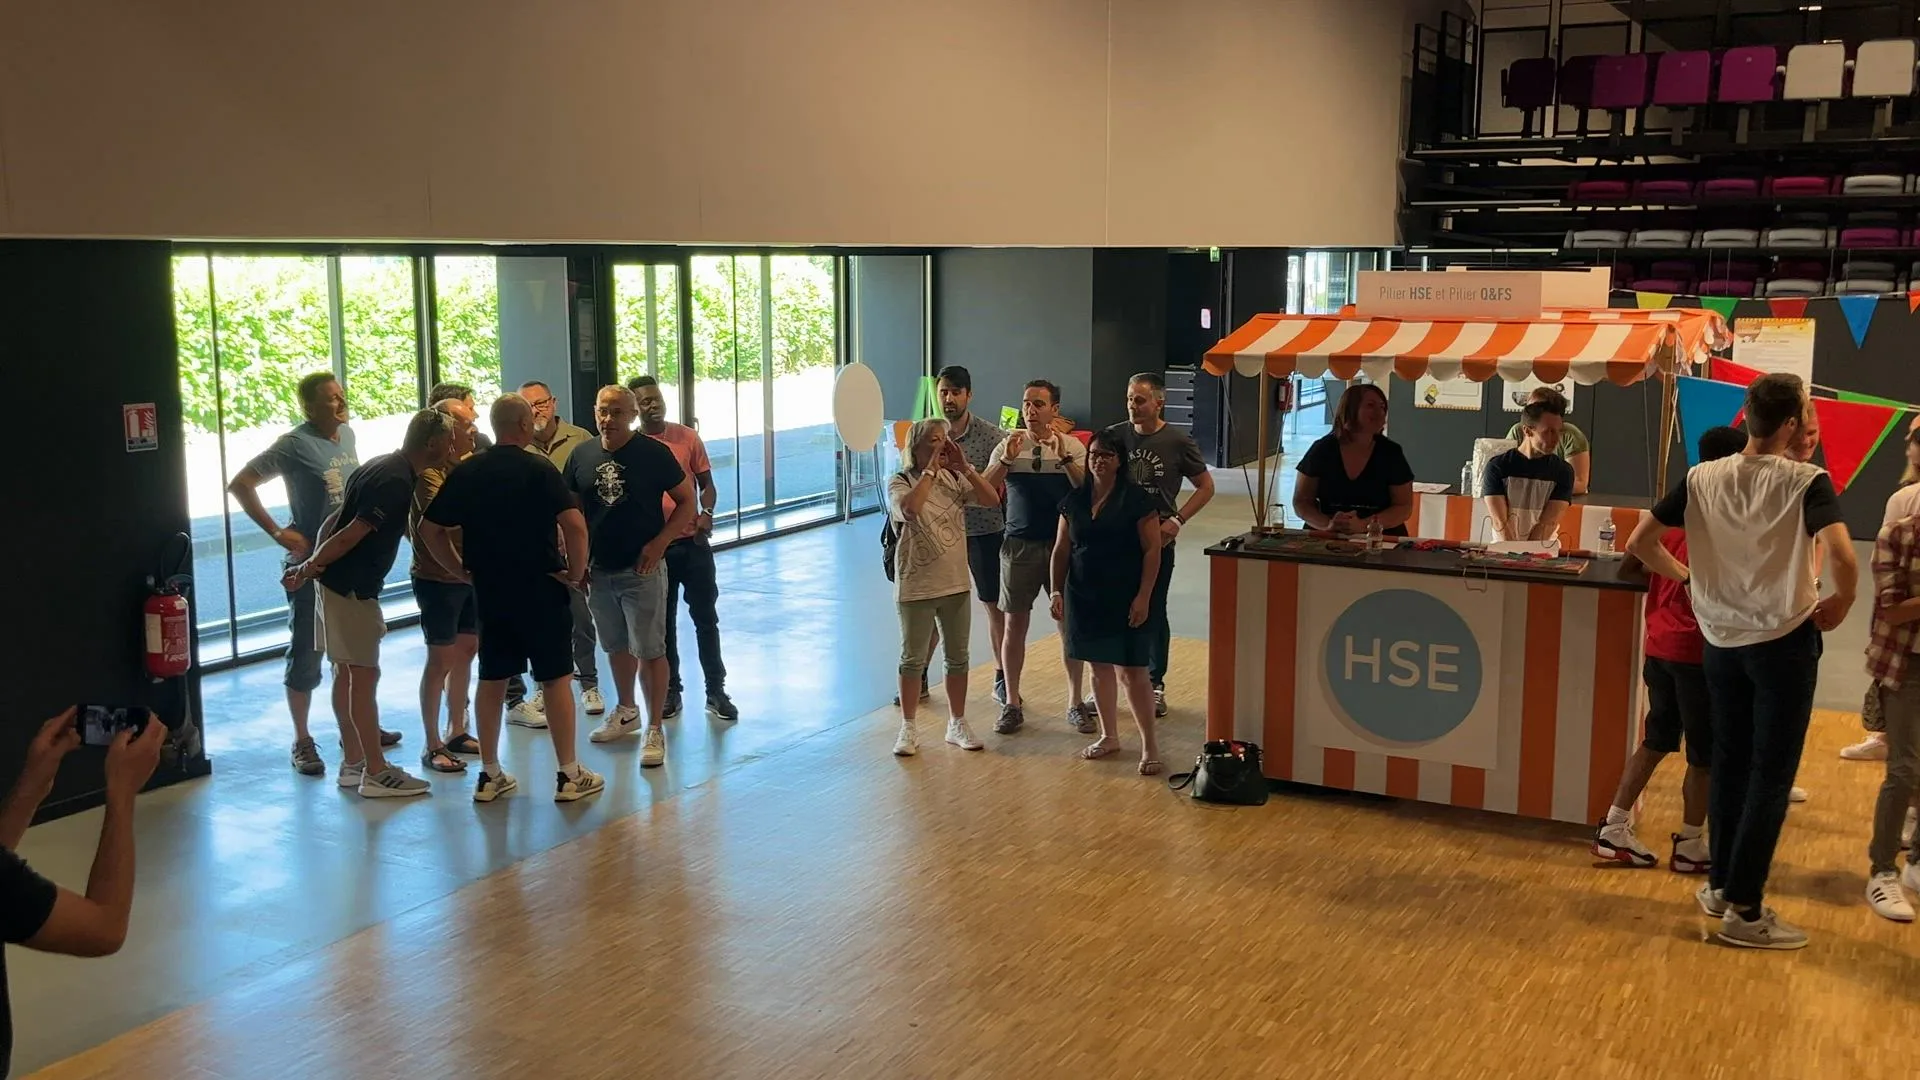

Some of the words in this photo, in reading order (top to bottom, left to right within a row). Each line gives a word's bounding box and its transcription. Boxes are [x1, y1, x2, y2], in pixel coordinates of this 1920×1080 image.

[1379, 286, 1406, 300] Pilier
[1409, 286, 1433, 300] HSE
[1435, 288, 1445, 300] et
[1449, 286, 1477, 301] Pilier
[1480, 287, 1512, 301] Q&FS
[1127, 448, 1165, 477] KSILVER
[1344, 635, 1460, 692] HSE
